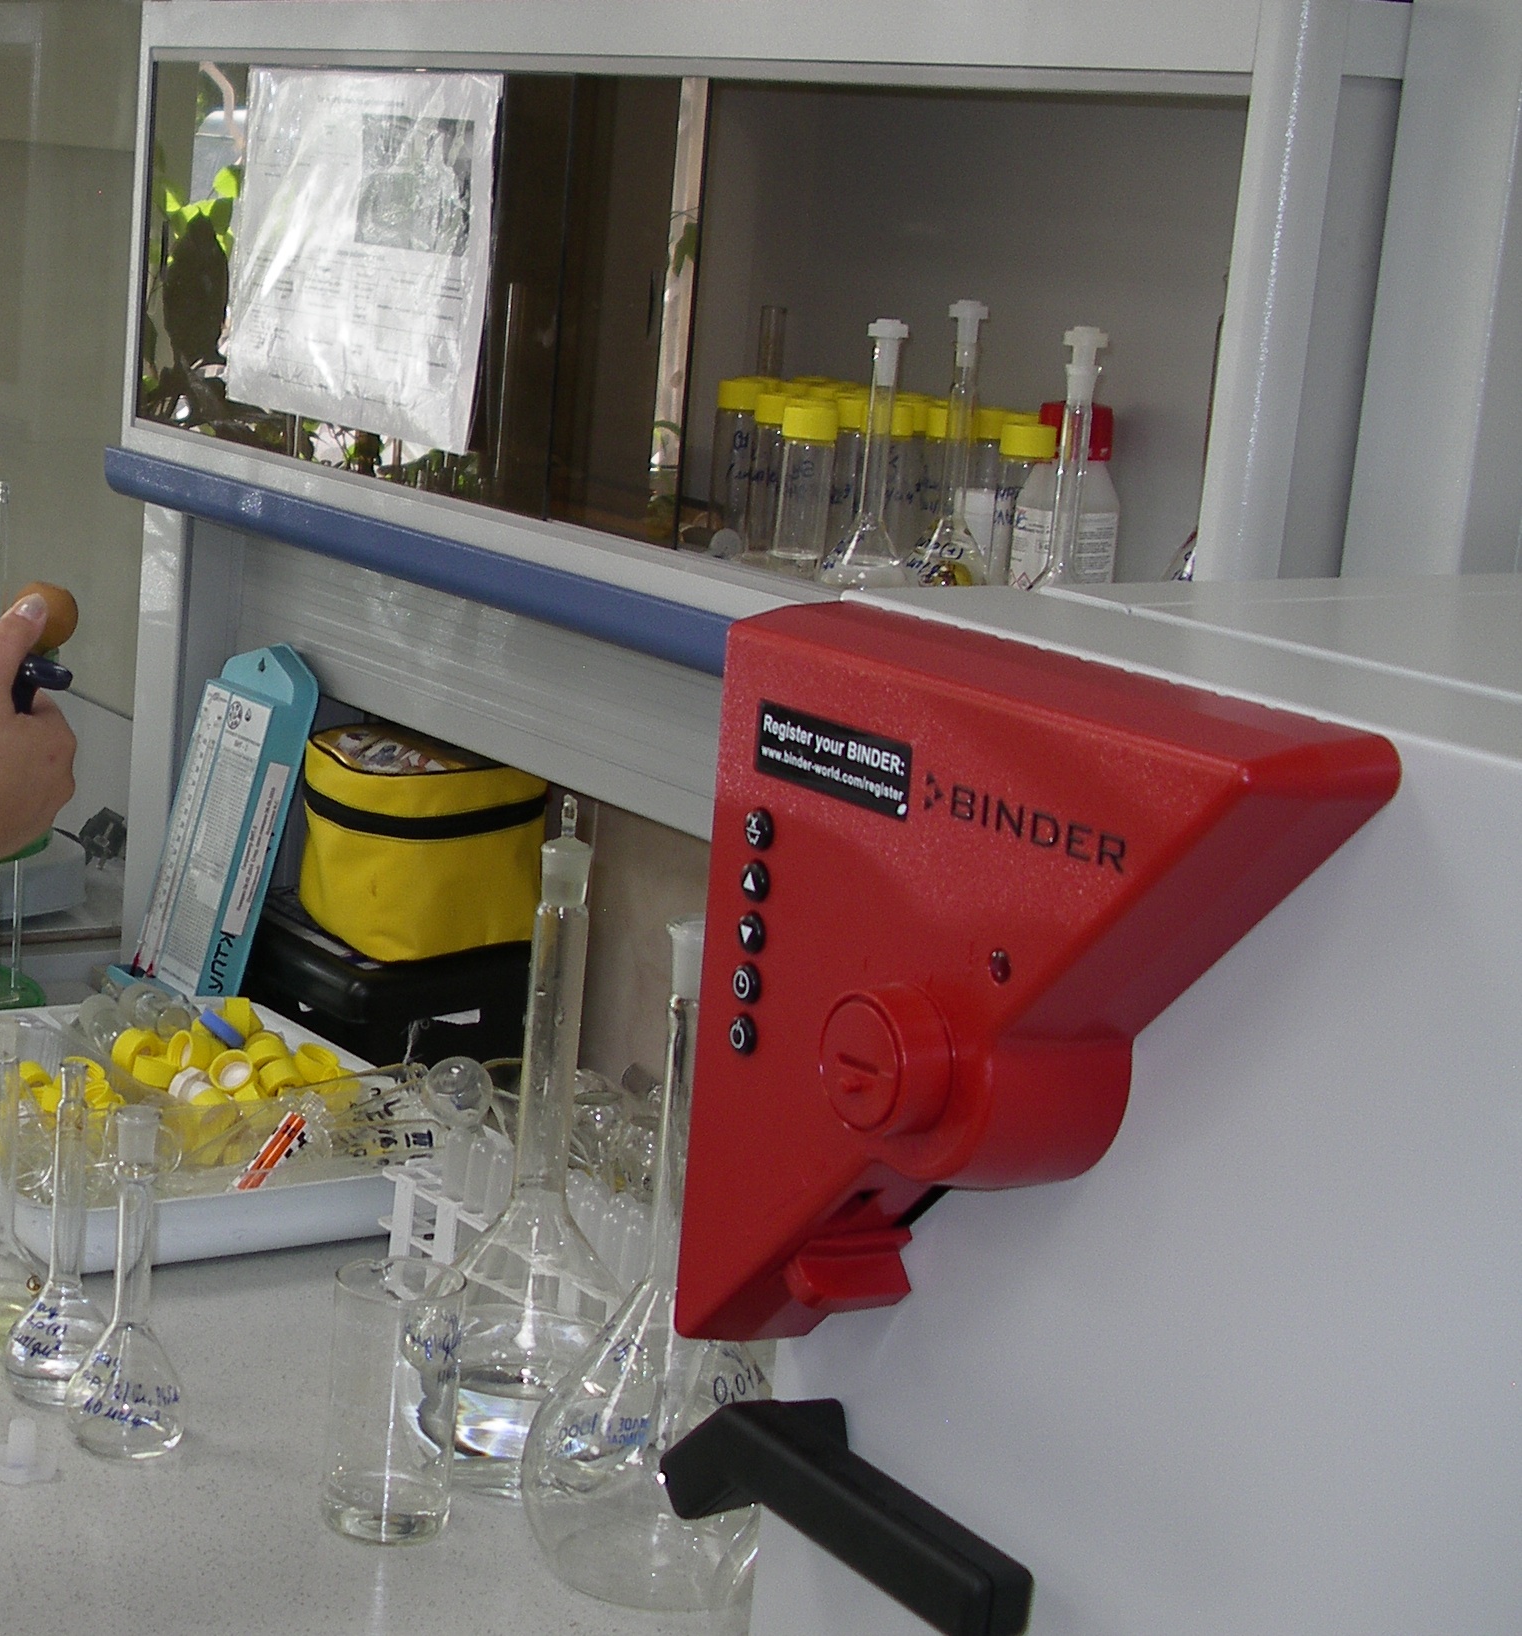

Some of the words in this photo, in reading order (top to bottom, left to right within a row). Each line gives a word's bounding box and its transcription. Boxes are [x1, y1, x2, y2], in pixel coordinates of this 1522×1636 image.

[761, 745, 905, 802] www.binder-world.com/register
[763, 713, 814, 746] Register
[814, 734, 846, 753] your
[846, 740, 905, 777] BINDER:
[951, 784, 1126, 874] BINDER
